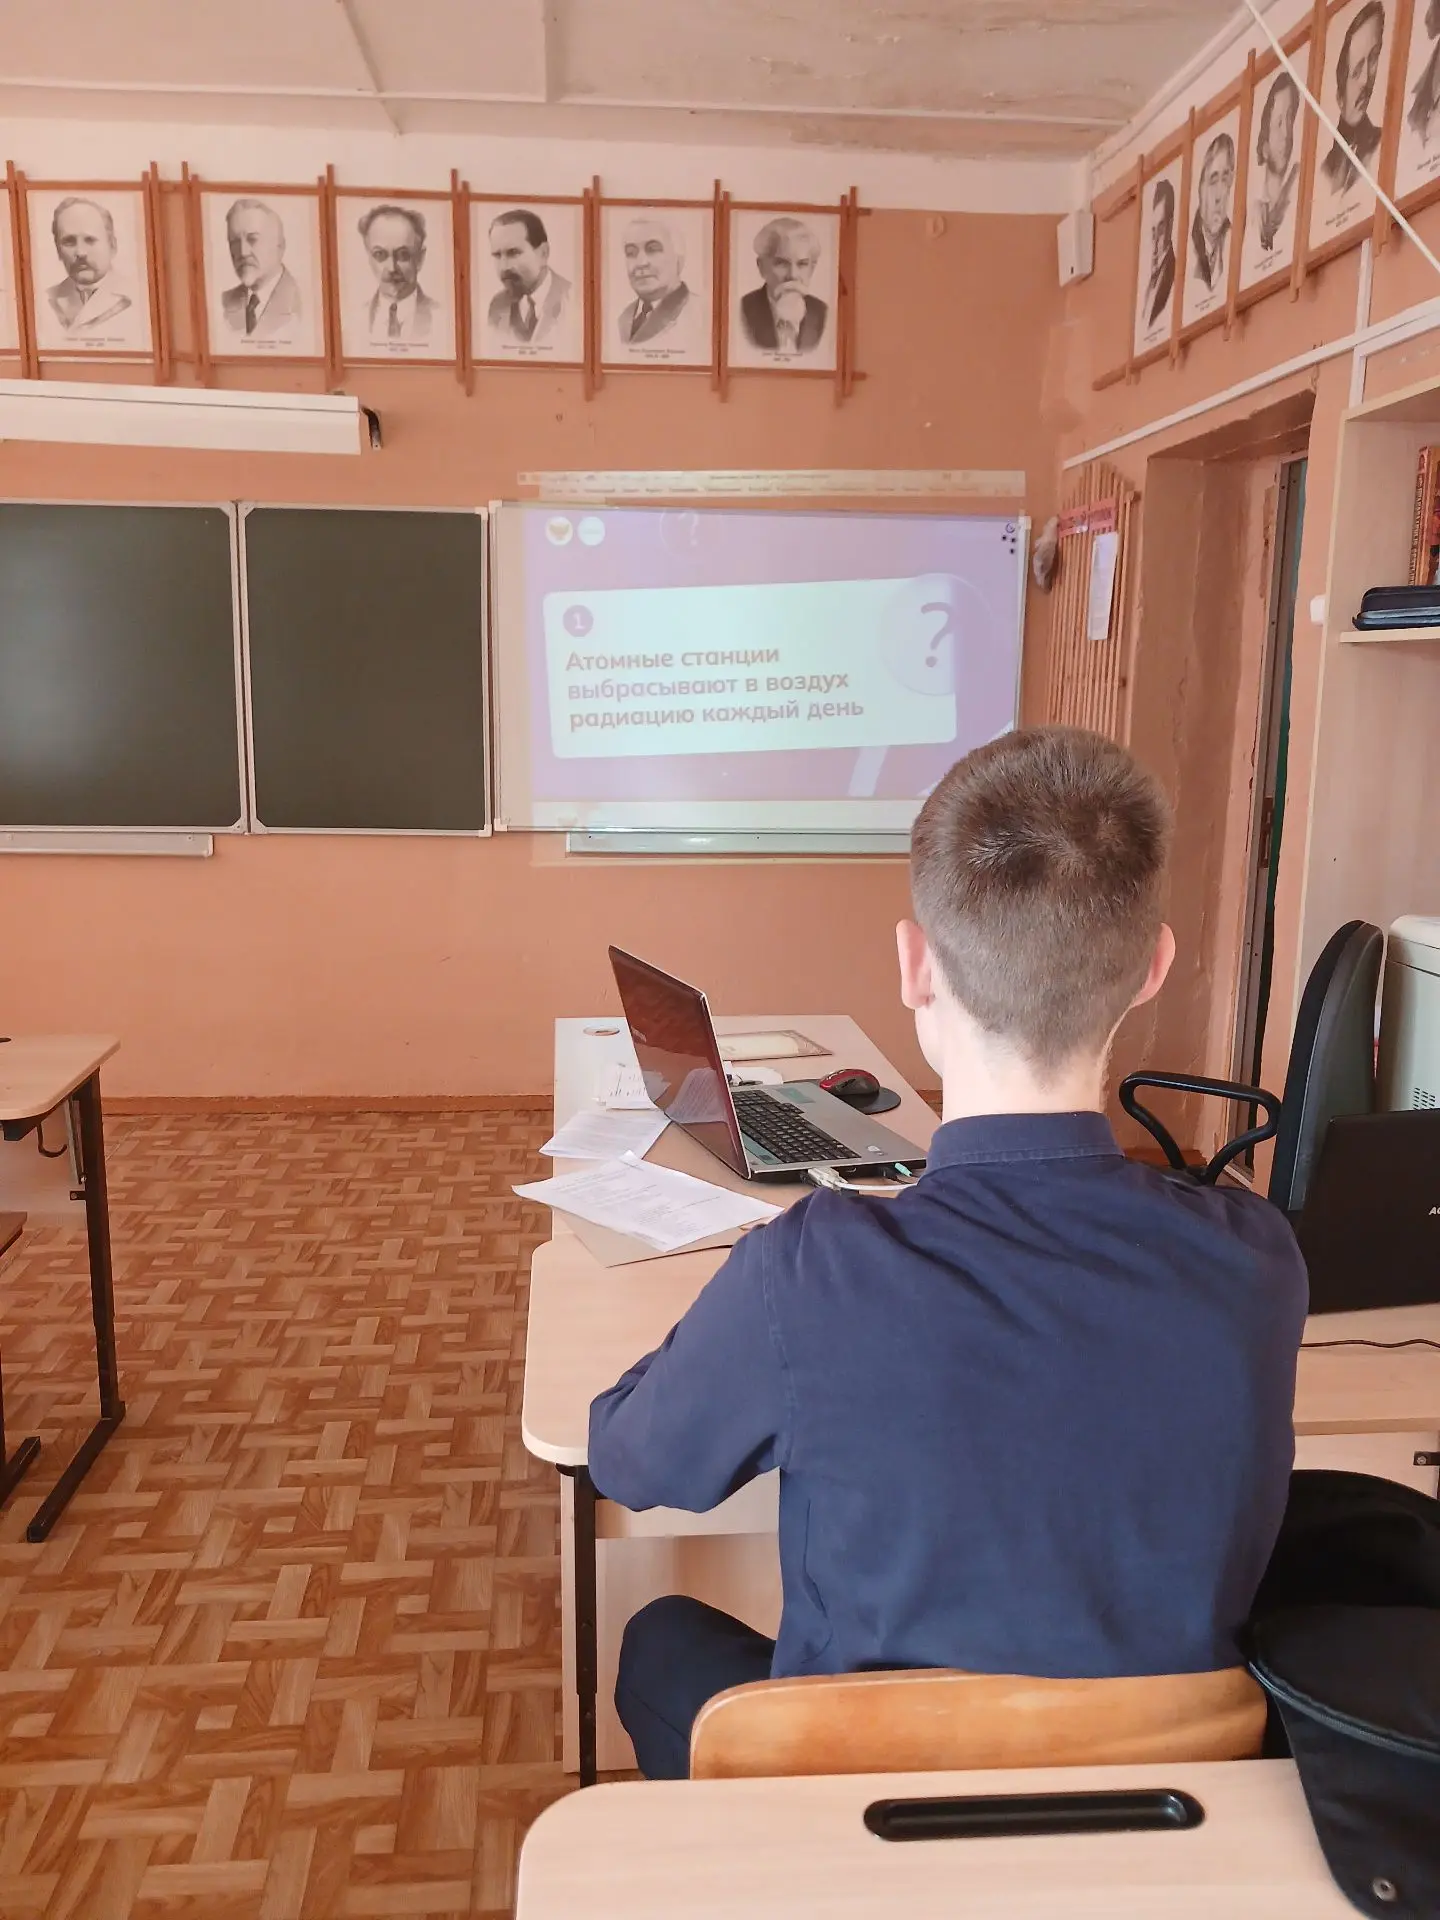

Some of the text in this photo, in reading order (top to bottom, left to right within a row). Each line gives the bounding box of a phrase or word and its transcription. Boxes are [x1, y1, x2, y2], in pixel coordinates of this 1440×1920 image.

[573, 612, 586, 630] 1
[565, 648, 780, 671] Атомные станции
[568, 673, 849, 703] выбрасывают в воздух
[569, 699, 865, 732] радиацию каждый день
